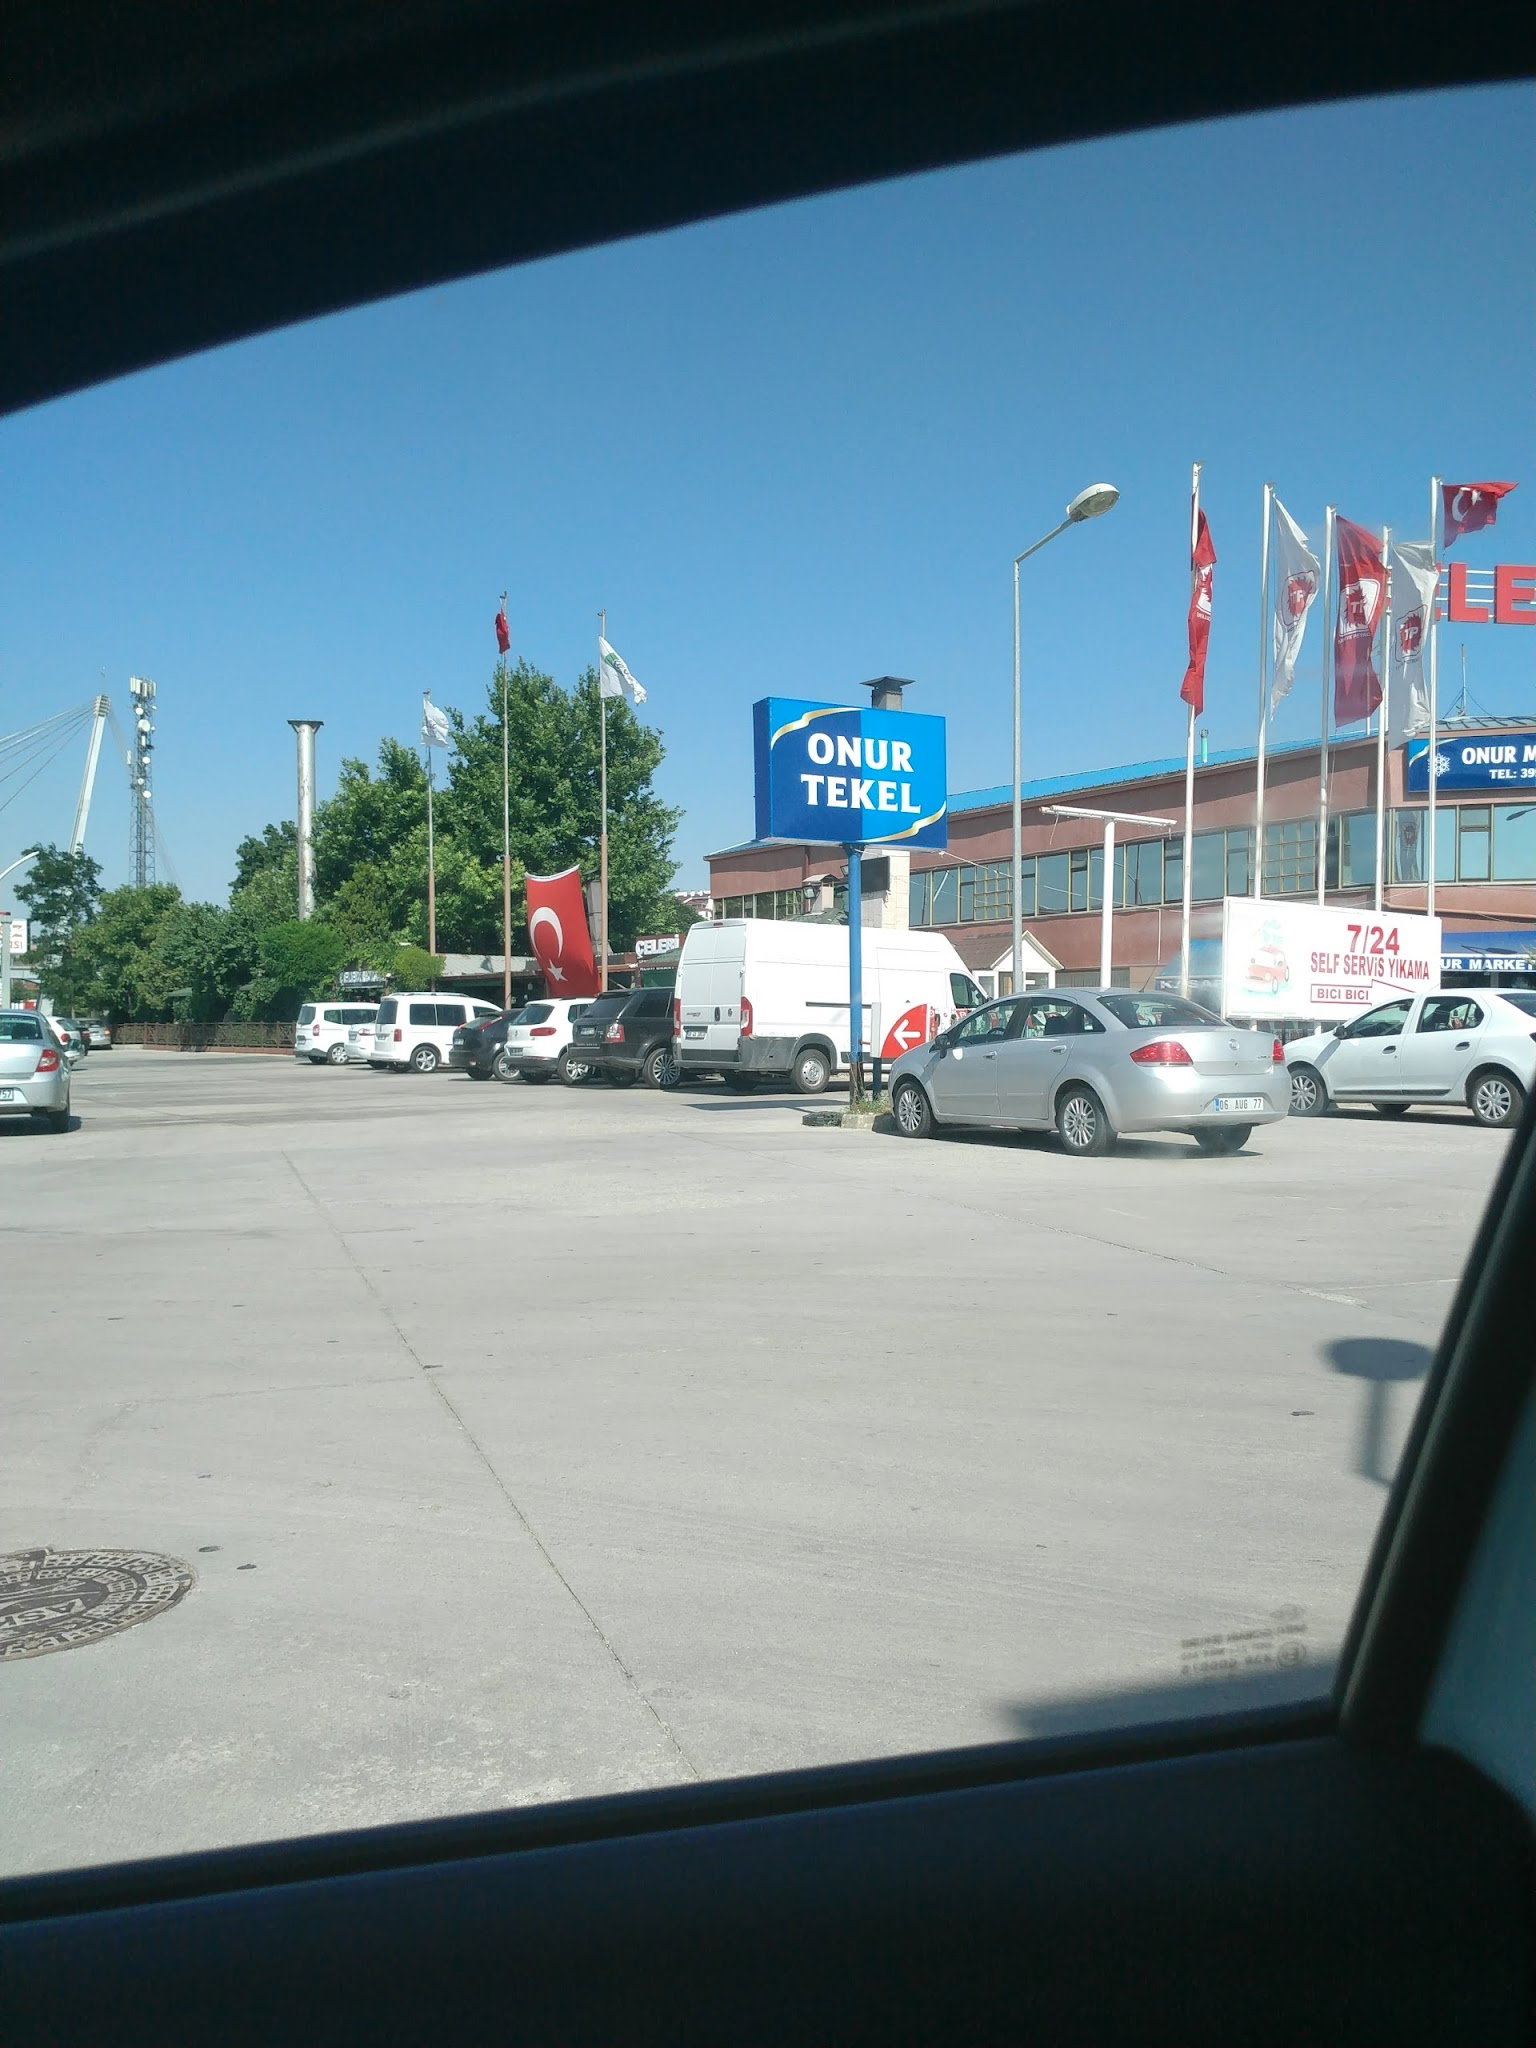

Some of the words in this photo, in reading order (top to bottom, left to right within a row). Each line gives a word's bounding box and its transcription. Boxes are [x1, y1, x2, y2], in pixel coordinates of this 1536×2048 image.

[1436, 562, 1536, 625] LE
[808, 732, 915, 773] ONUR
[1461, 746, 1517, 765] ONUR
[1489, 768, 1518, 779] TEL:
[1520, 767, 1536, 778] 39
[801, 773, 921, 814] TEKEL
[1347, 924, 1400, 955] 7/24
[1310, 951, 1340, 974] SELF
[1388, 957, 1430, 980] YIKAMA
[1317, 988, 1341, 999] BICI
[1345, 989, 1369, 1001] BICI
[1220, 1100, 1229, 1110] 06
[1235, 1099, 1248, 1110] AUG
[1254, 1099, 1261, 1109] 77
